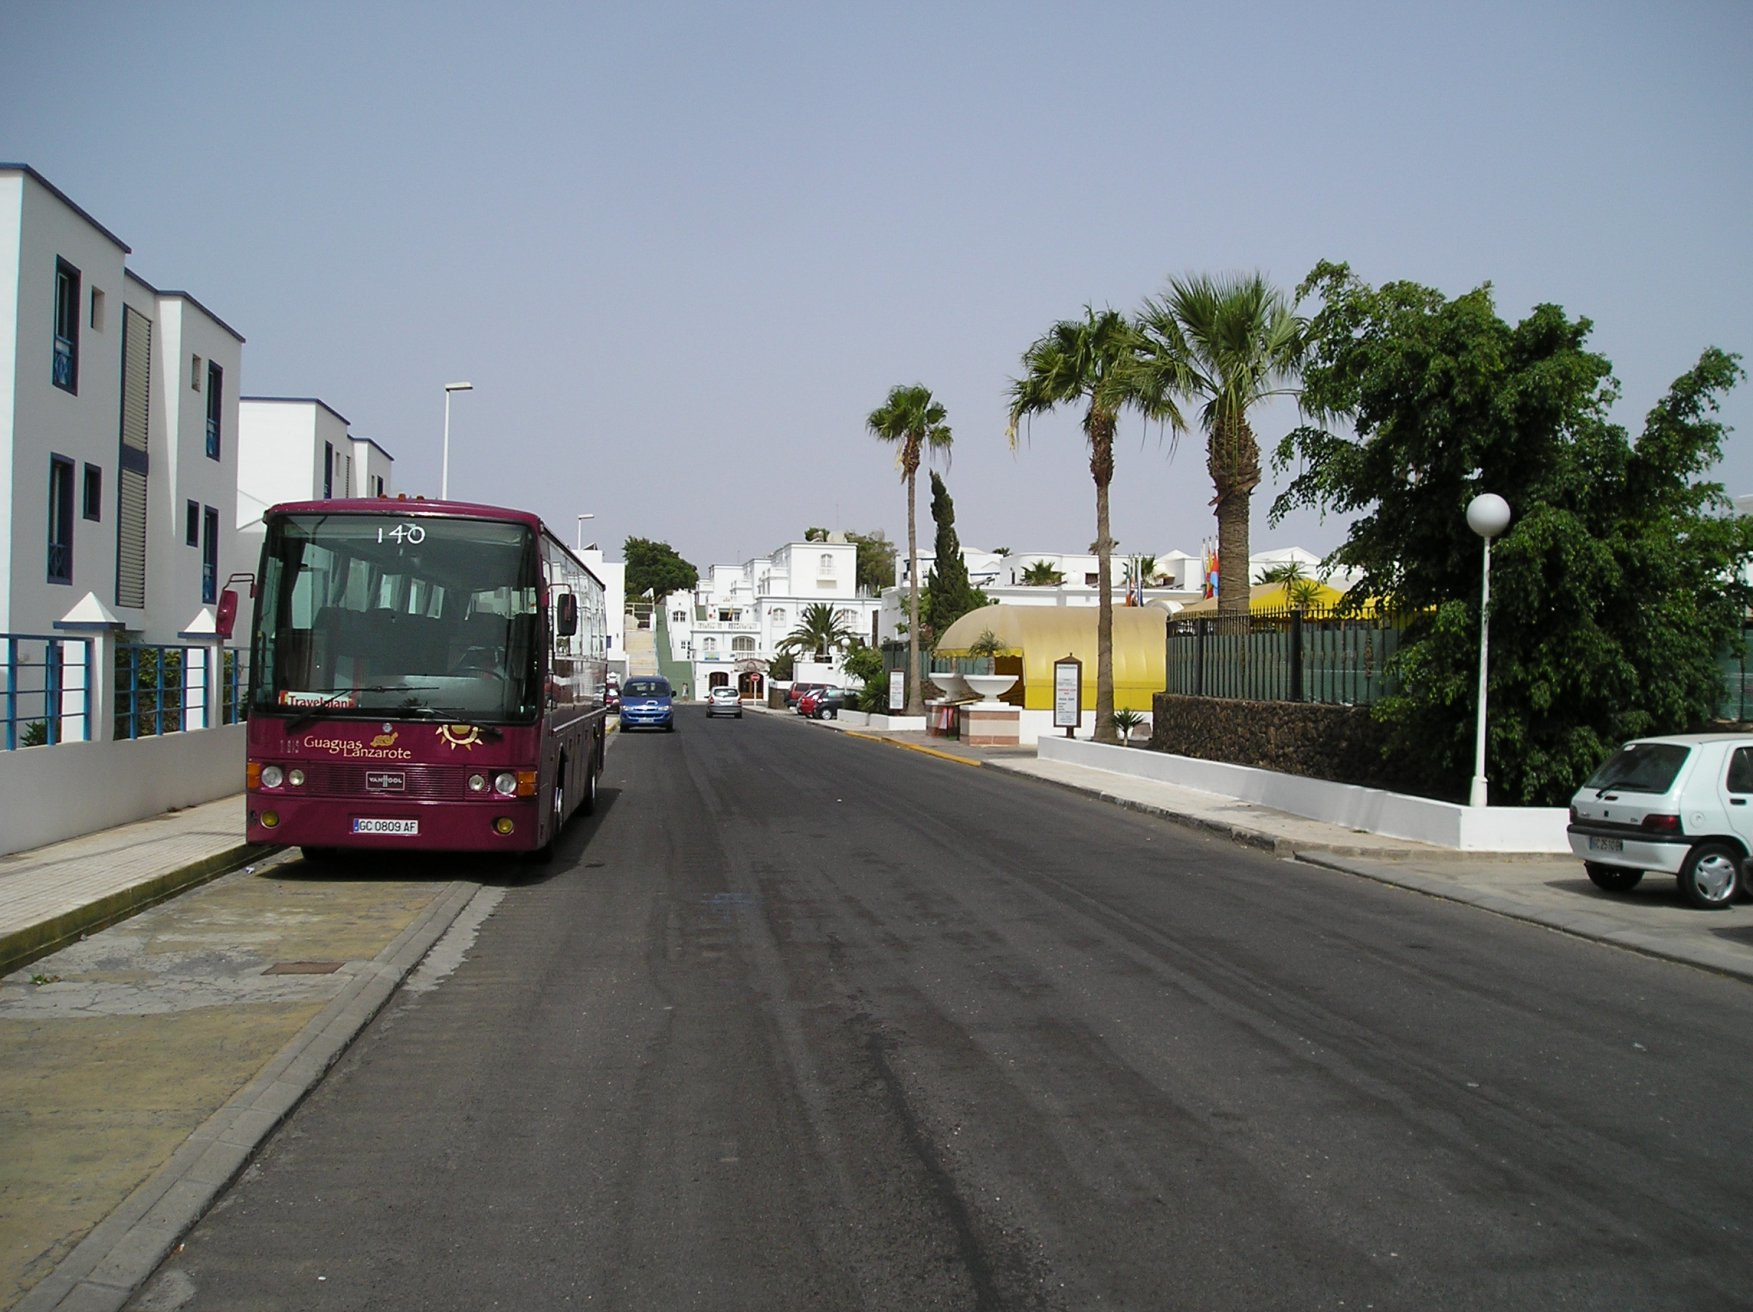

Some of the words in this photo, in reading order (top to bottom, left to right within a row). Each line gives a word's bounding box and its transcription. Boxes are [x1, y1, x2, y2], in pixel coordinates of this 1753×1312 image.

[377, 524, 426, 545] 140
[303, 735, 363, 754] Guaguas
[343, 747, 412, 759] Lanzarote
[359, 820, 373, 832] GC
[374, 821, 401, 833] 0809
[403, 821, 417, 832] AF
